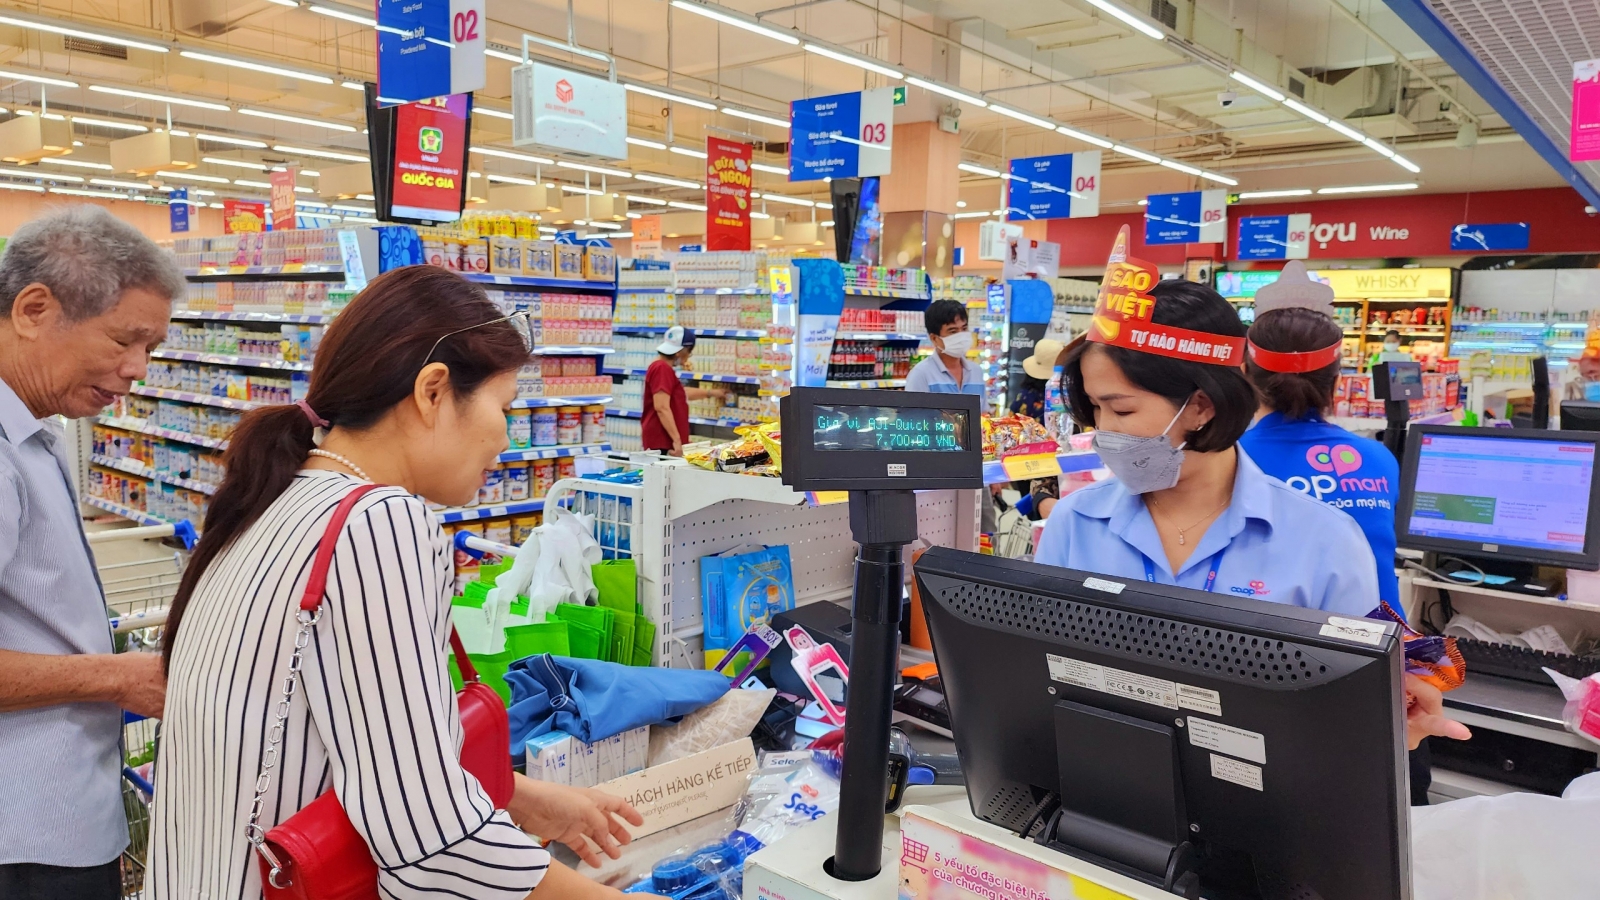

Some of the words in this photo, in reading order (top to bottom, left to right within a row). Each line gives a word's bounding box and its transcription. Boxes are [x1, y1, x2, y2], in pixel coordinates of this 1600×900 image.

[453, 9, 479, 43] 02
[863, 123, 886, 143] 03
[714, 156, 735, 171] BỮA
[402, 171, 434, 187] QUỐC
[435, 177, 455, 189] GIA
[719, 171, 751, 188] NGON
[1075, 176, 1096, 192] 04
[1203, 210, 1221, 222] 05
[1289, 231, 1305, 242] 06
[1370, 226, 1409, 241] Wine
[1110, 268, 1152, 291] SAO
[1355, 274, 1421, 289] WHISKY
[1106, 292, 1153, 321] VIỆT
[1010, 339, 1034, 349] Legend
[1131, 329, 1148, 347] TỰ
[1148, 332, 1176, 351] HÀO
[1178, 337, 1211, 359] HÀNG
[1212, 343, 1233, 361] VIỆT
[817, 416, 839, 429] Gia
[847, 417, 860, 430] vi
[868, 418, 929, 431] AJI-Quick
[935, 435, 956, 447] VND
[1356, 497, 1376, 509] mọi
[625, 786, 663, 808] HÁCH
[666, 773, 704, 796] HÀNG
[706, 762, 724, 782] KẾ
[725, 755, 752, 777] TIẾP
[934, 852, 941, 862] 5
[944, 853, 963, 873] yếu
[966, 862, 978, 877] tố
[981, 870, 1001, 888] đặc
[1004, 878, 1028, 898] biệt
[758, 885, 770, 896] Nhà
[933, 867, 952, 883] của
[955, 875, 996, 900] chương
